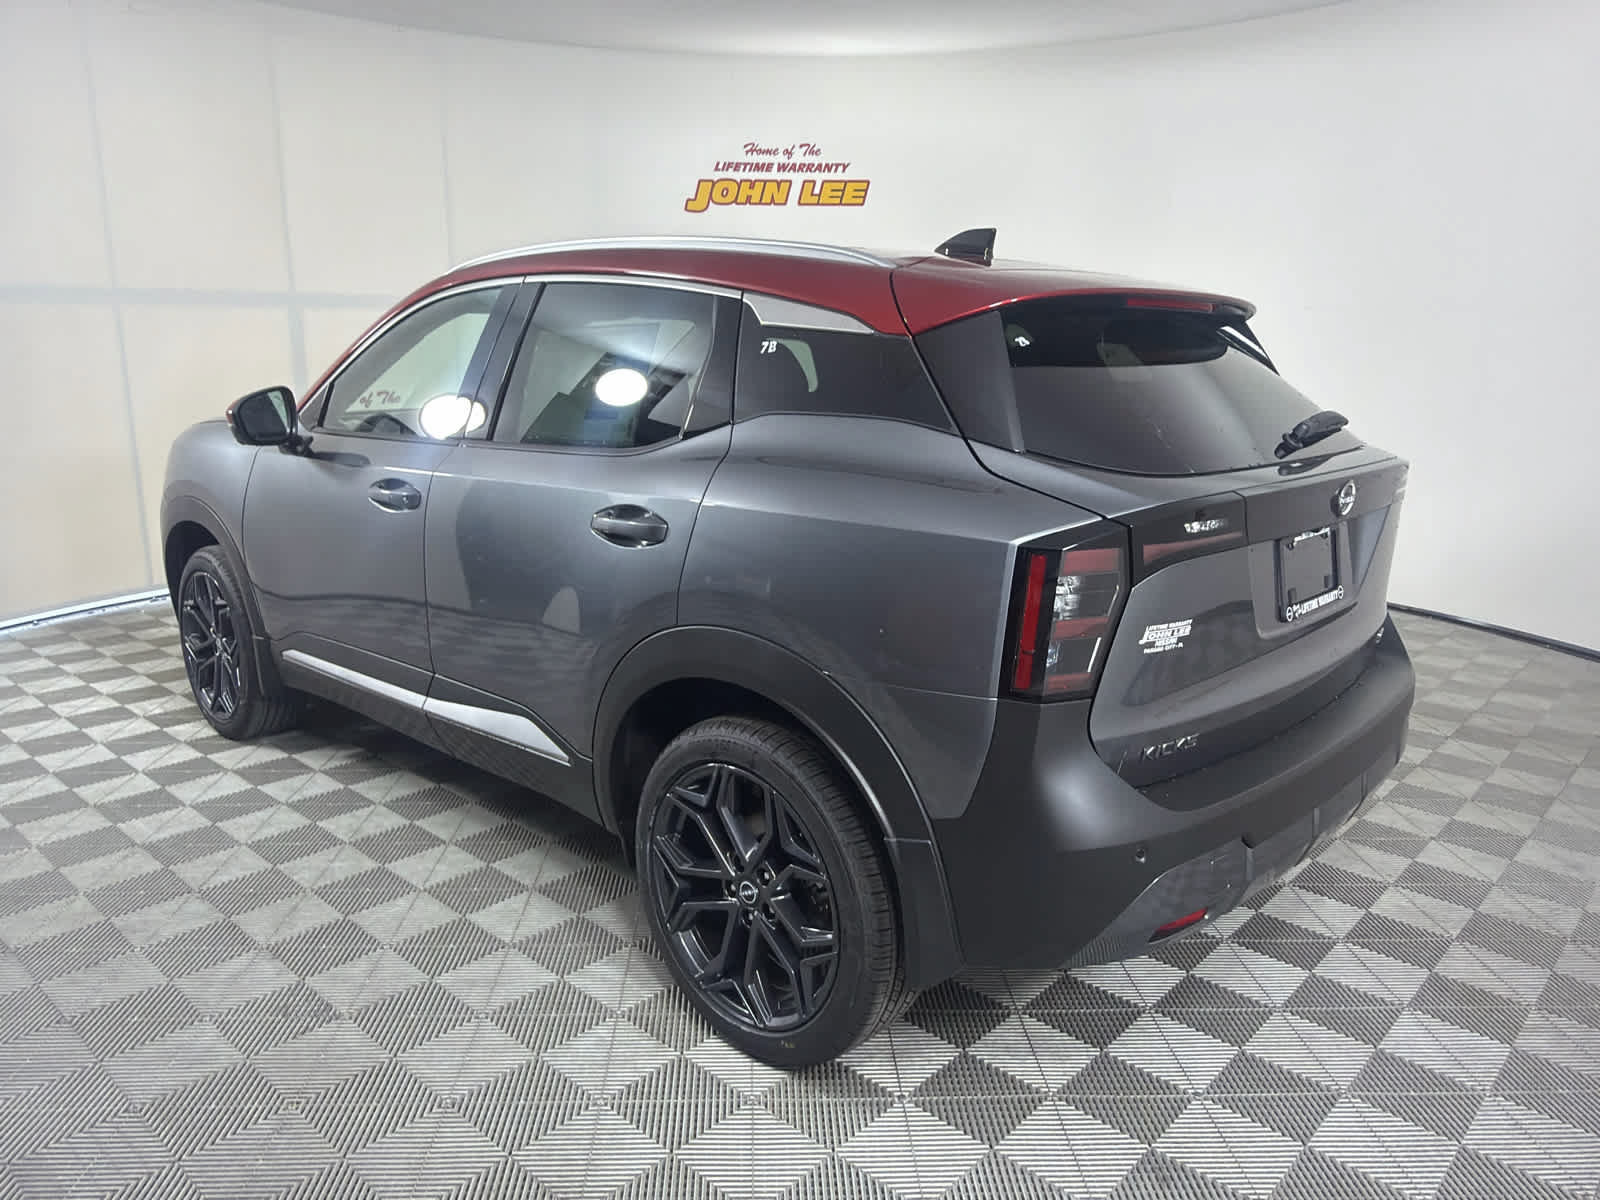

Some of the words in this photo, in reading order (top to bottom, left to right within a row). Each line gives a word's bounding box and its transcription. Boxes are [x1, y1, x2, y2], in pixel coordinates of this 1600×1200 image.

[744, 142, 779, 156] Home
[782, 145, 794, 159] of
[799, 144, 821, 156] The
[714, 161, 775, 173] LIFETIME
[777, 162, 850, 173] WARRANTY
[684, 178, 792, 213] JOHN
[798, 179, 870, 206] LEE
[1143, 733, 1200, 760] KICKS
